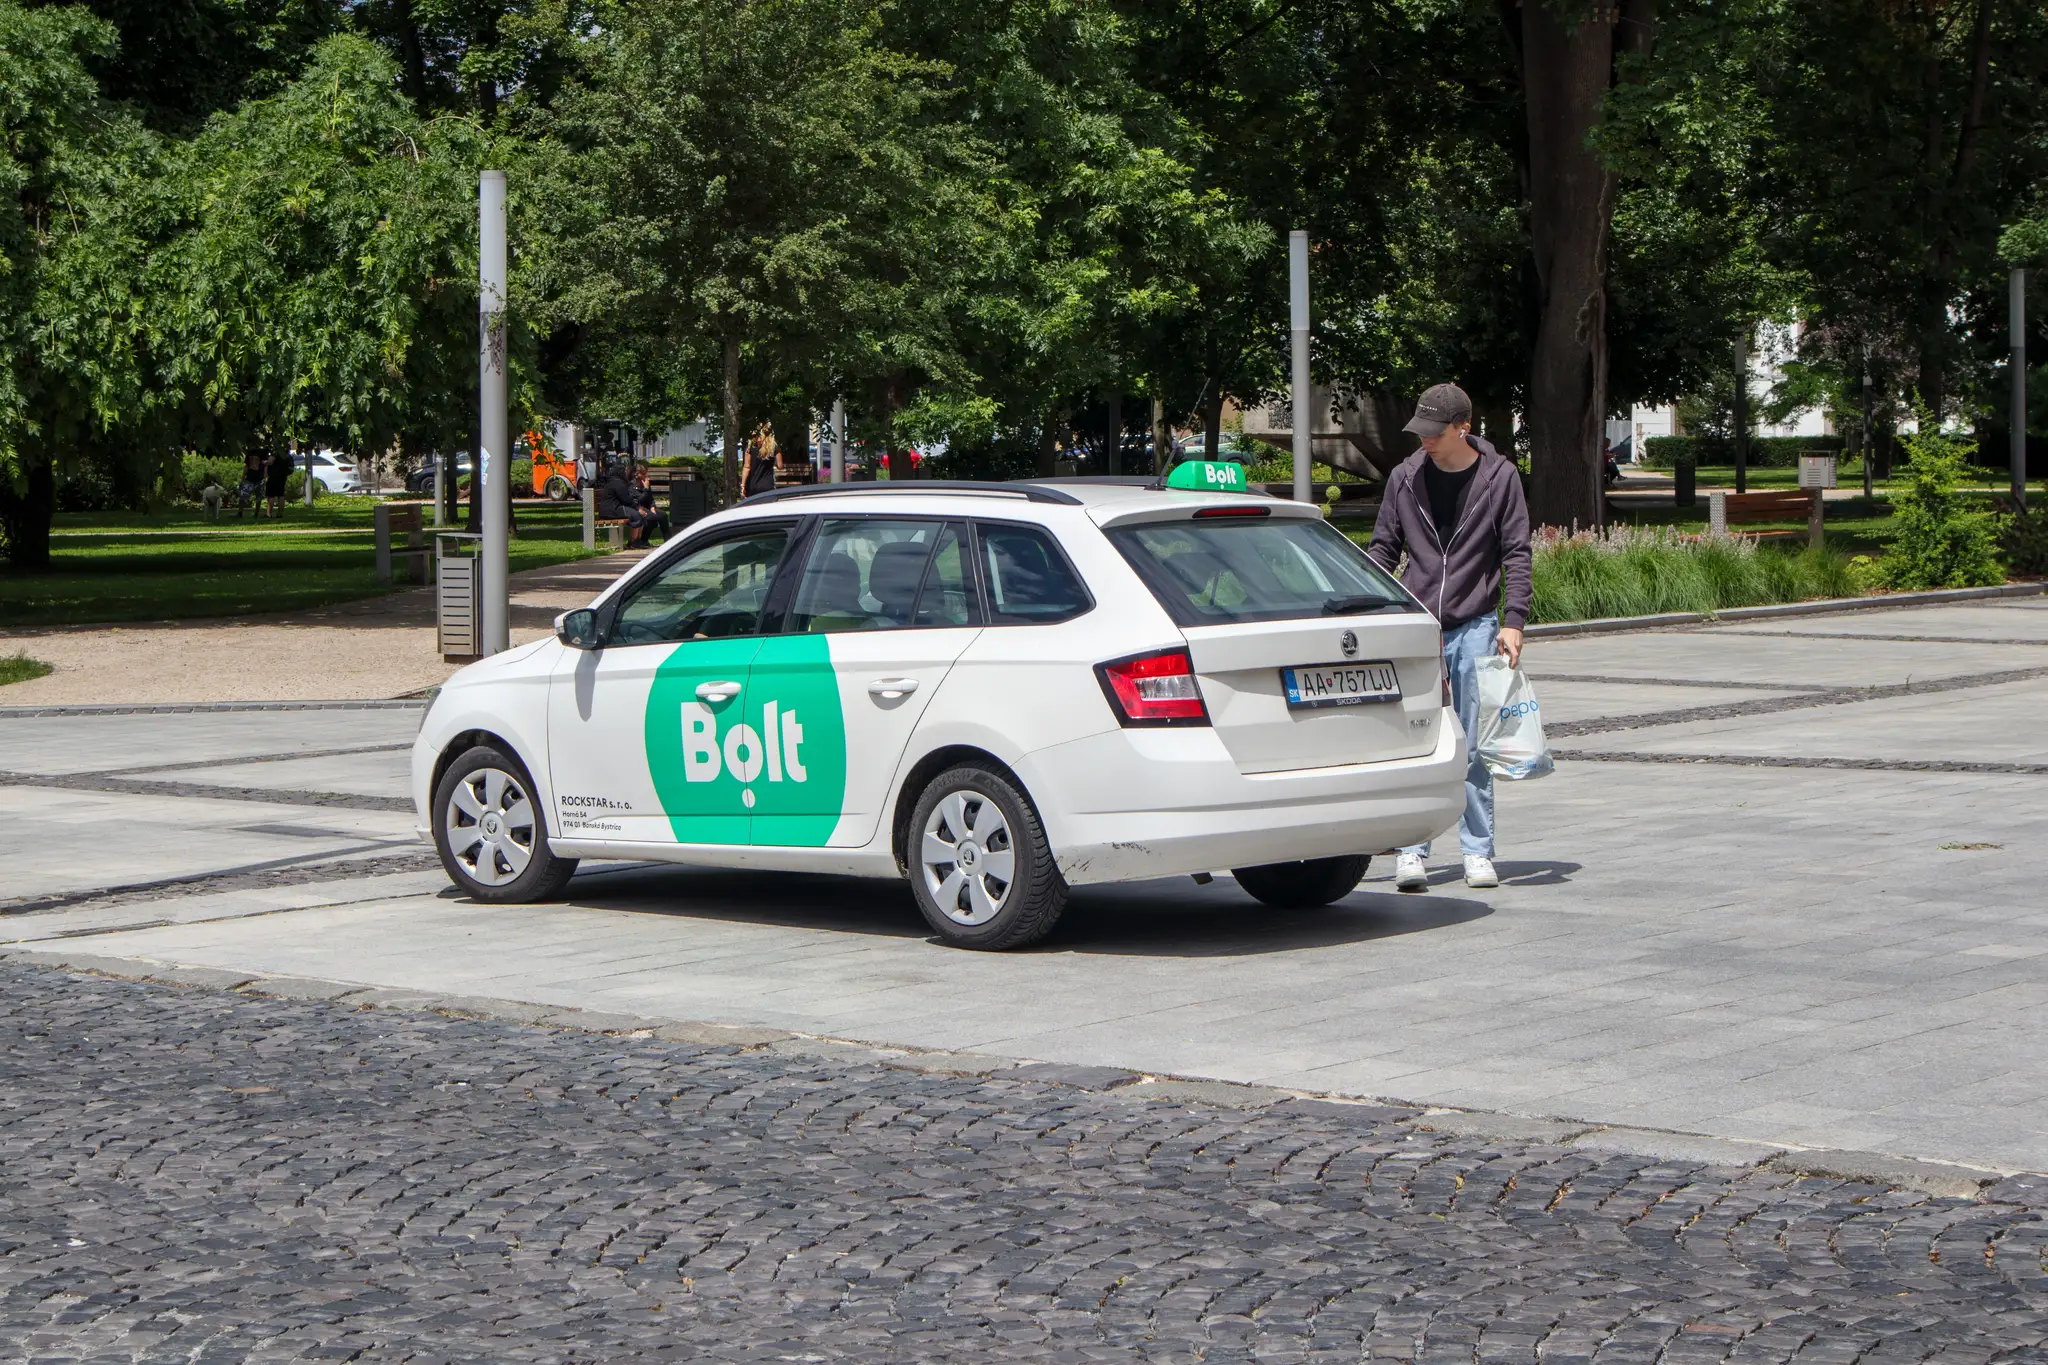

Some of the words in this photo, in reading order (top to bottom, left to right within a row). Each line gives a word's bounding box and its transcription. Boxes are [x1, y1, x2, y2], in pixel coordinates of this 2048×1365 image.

[1204, 463, 1237, 485] Bolt
[1289, 688, 1299, 698] SK
[1303, 672, 1328, 696] AA
[1332, 669, 1392, 693] 757LU
[680, 699, 808, 783] Bolt
[562, 796, 608, 807] ROCKSTAR
